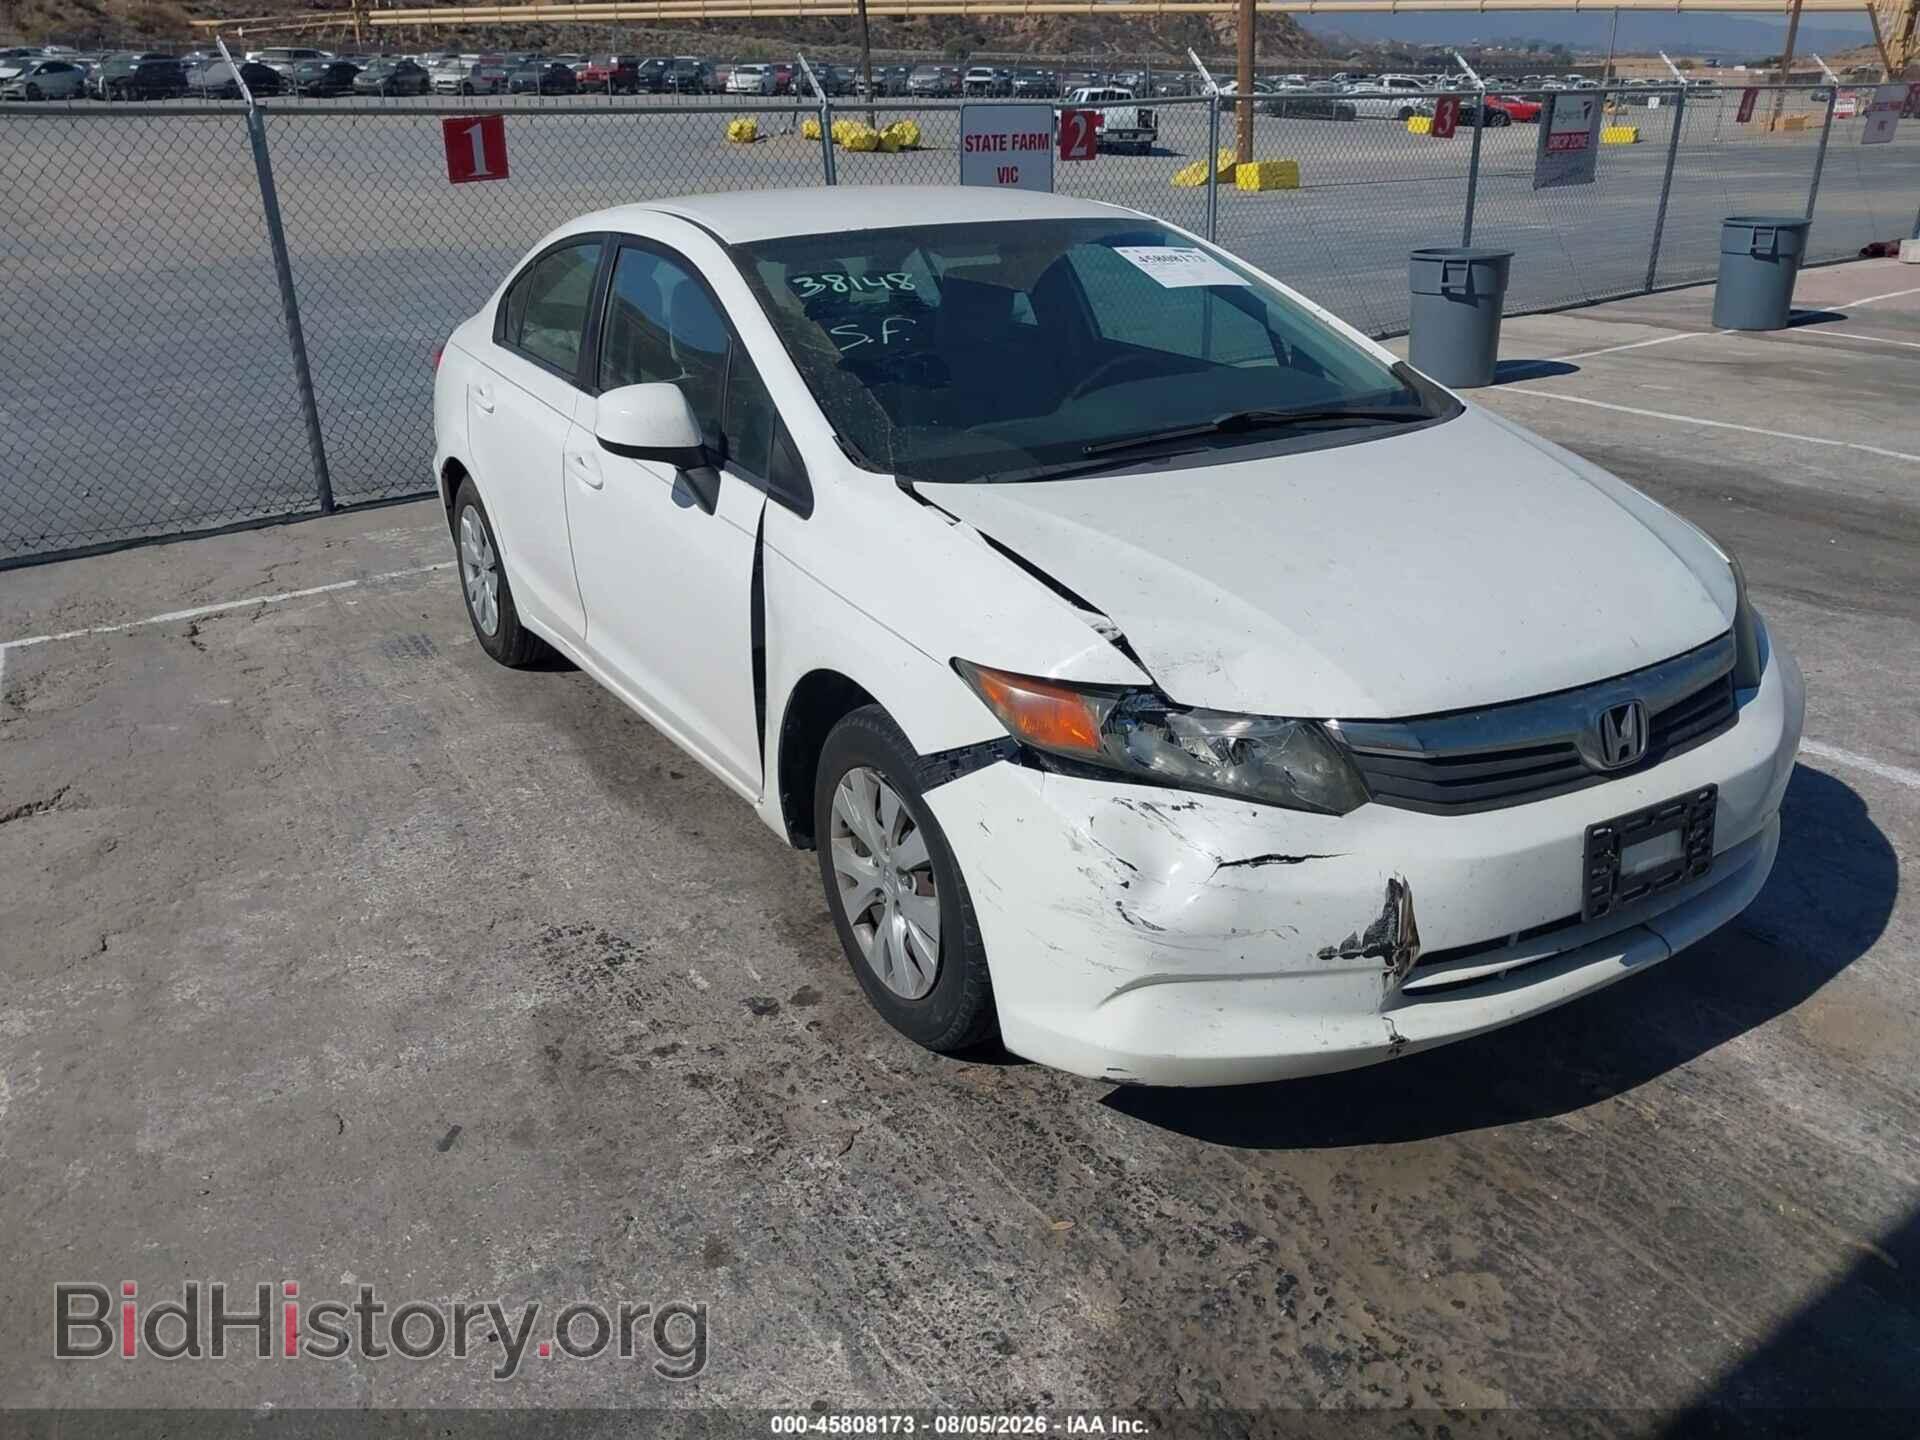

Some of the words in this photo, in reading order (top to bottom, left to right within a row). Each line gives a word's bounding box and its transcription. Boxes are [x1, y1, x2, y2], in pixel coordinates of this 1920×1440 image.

[1439, 102, 1453, 134] 3
[463, 123, 496, 176] 1
[965, 134, 1007, 152] STATE
[1011, 133, 1050, 151] FARM
[1069, 115, 1087, 156] 2
[996, 166, 1019, 184] VIC
[792, 272, 917, 298] 38148
